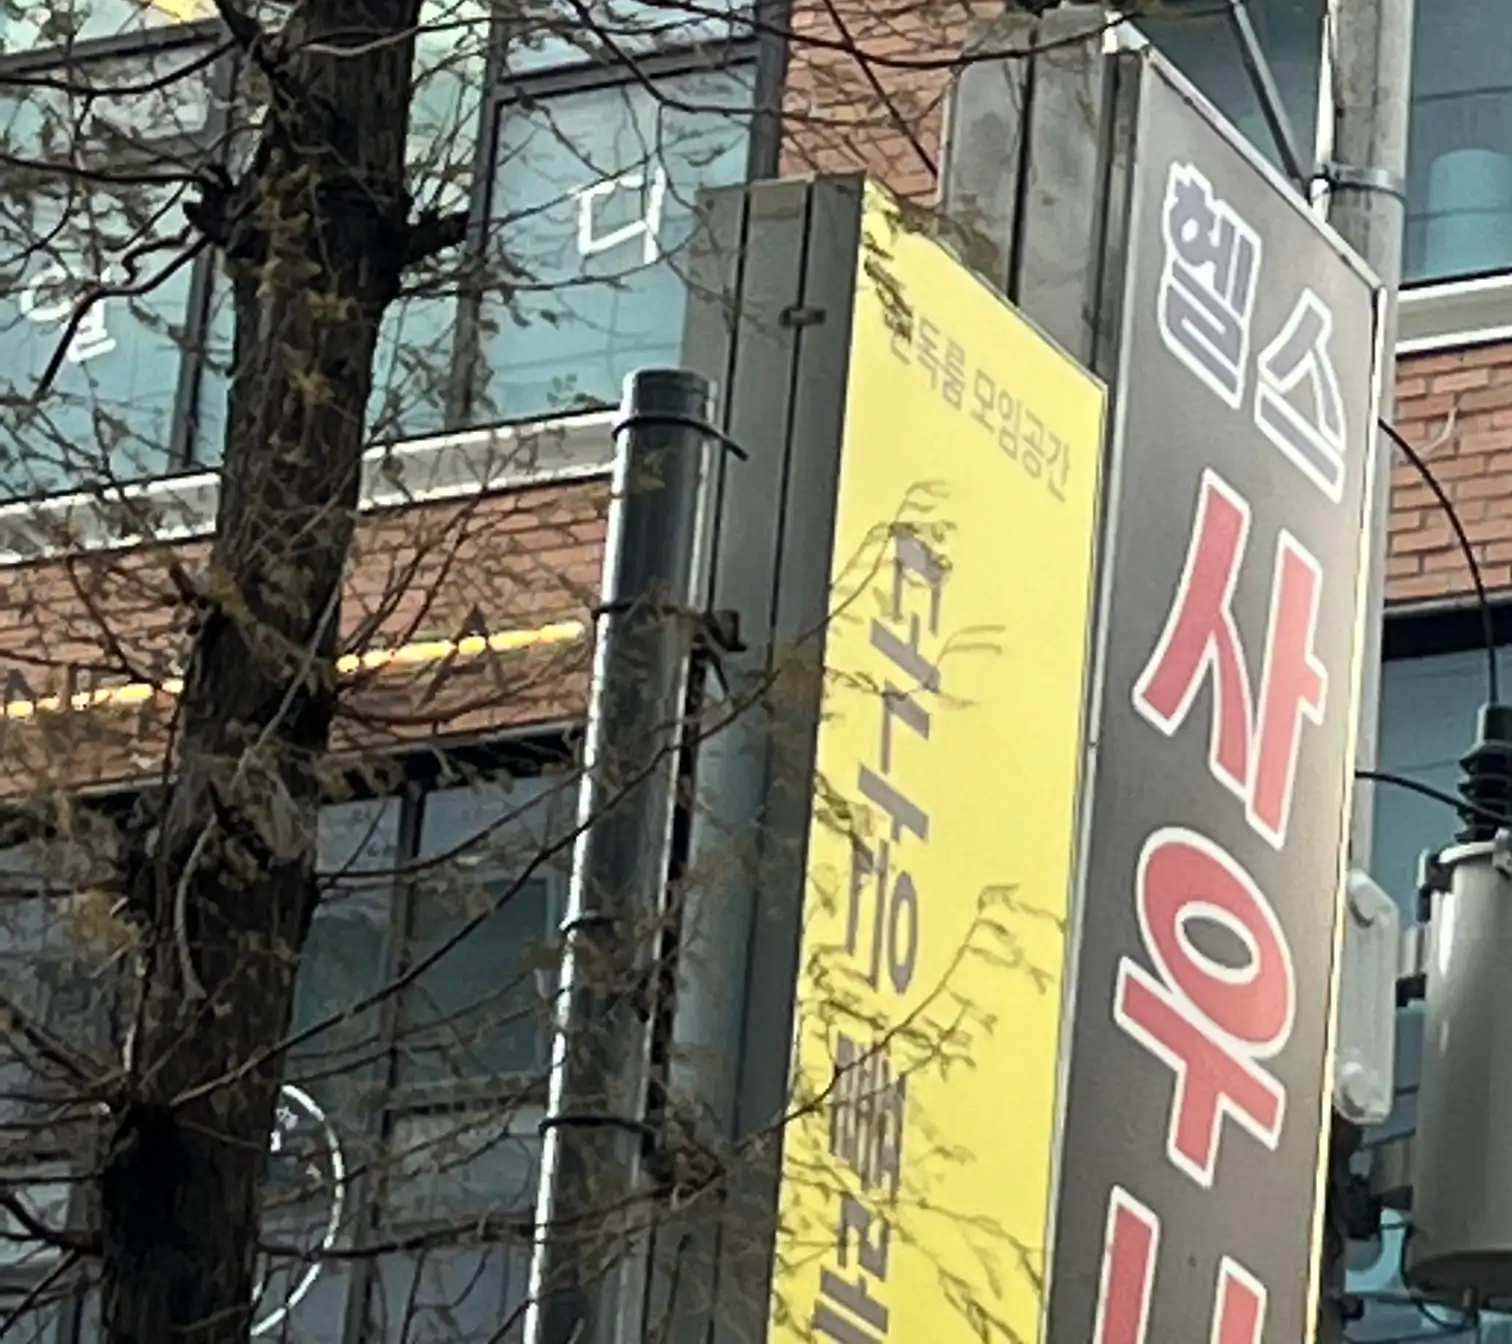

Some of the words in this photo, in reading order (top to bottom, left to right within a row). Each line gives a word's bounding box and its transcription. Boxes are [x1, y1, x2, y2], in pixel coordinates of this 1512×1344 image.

[887, 297, 966, 411] 독룸
[970, 368, 1071, 504] 모임공간
[1157, 162, 1346, 503] 헬스
